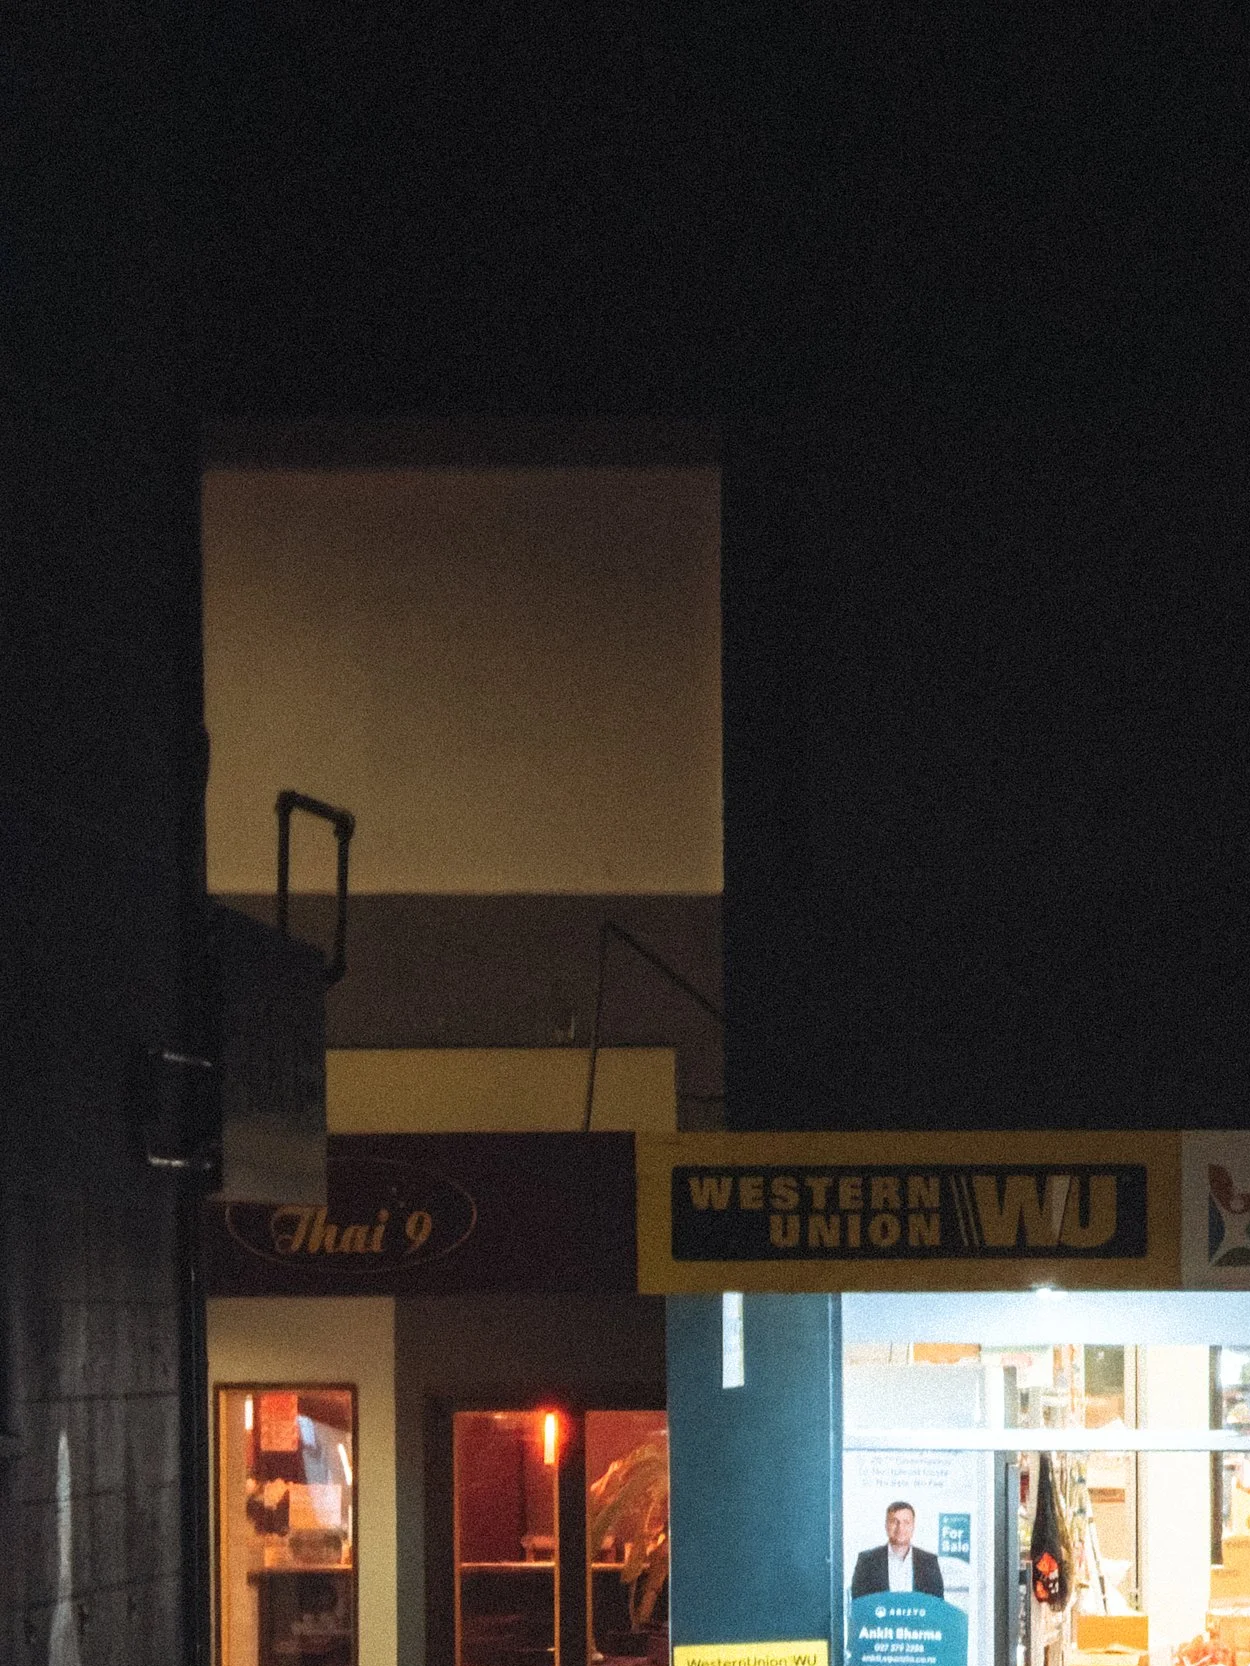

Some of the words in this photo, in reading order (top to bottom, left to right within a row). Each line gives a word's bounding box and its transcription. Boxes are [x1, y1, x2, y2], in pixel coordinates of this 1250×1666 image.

[689, 1175, 941, 1211] WESTERN
[973, 1174, 1118, 1248] WU
[271, 1204, 391, 1254] Thai
[404, 1210, 433, 1254] 9
[769, 1214, 941, 1247] UNION
[942, 1526, 964, 1540] For
